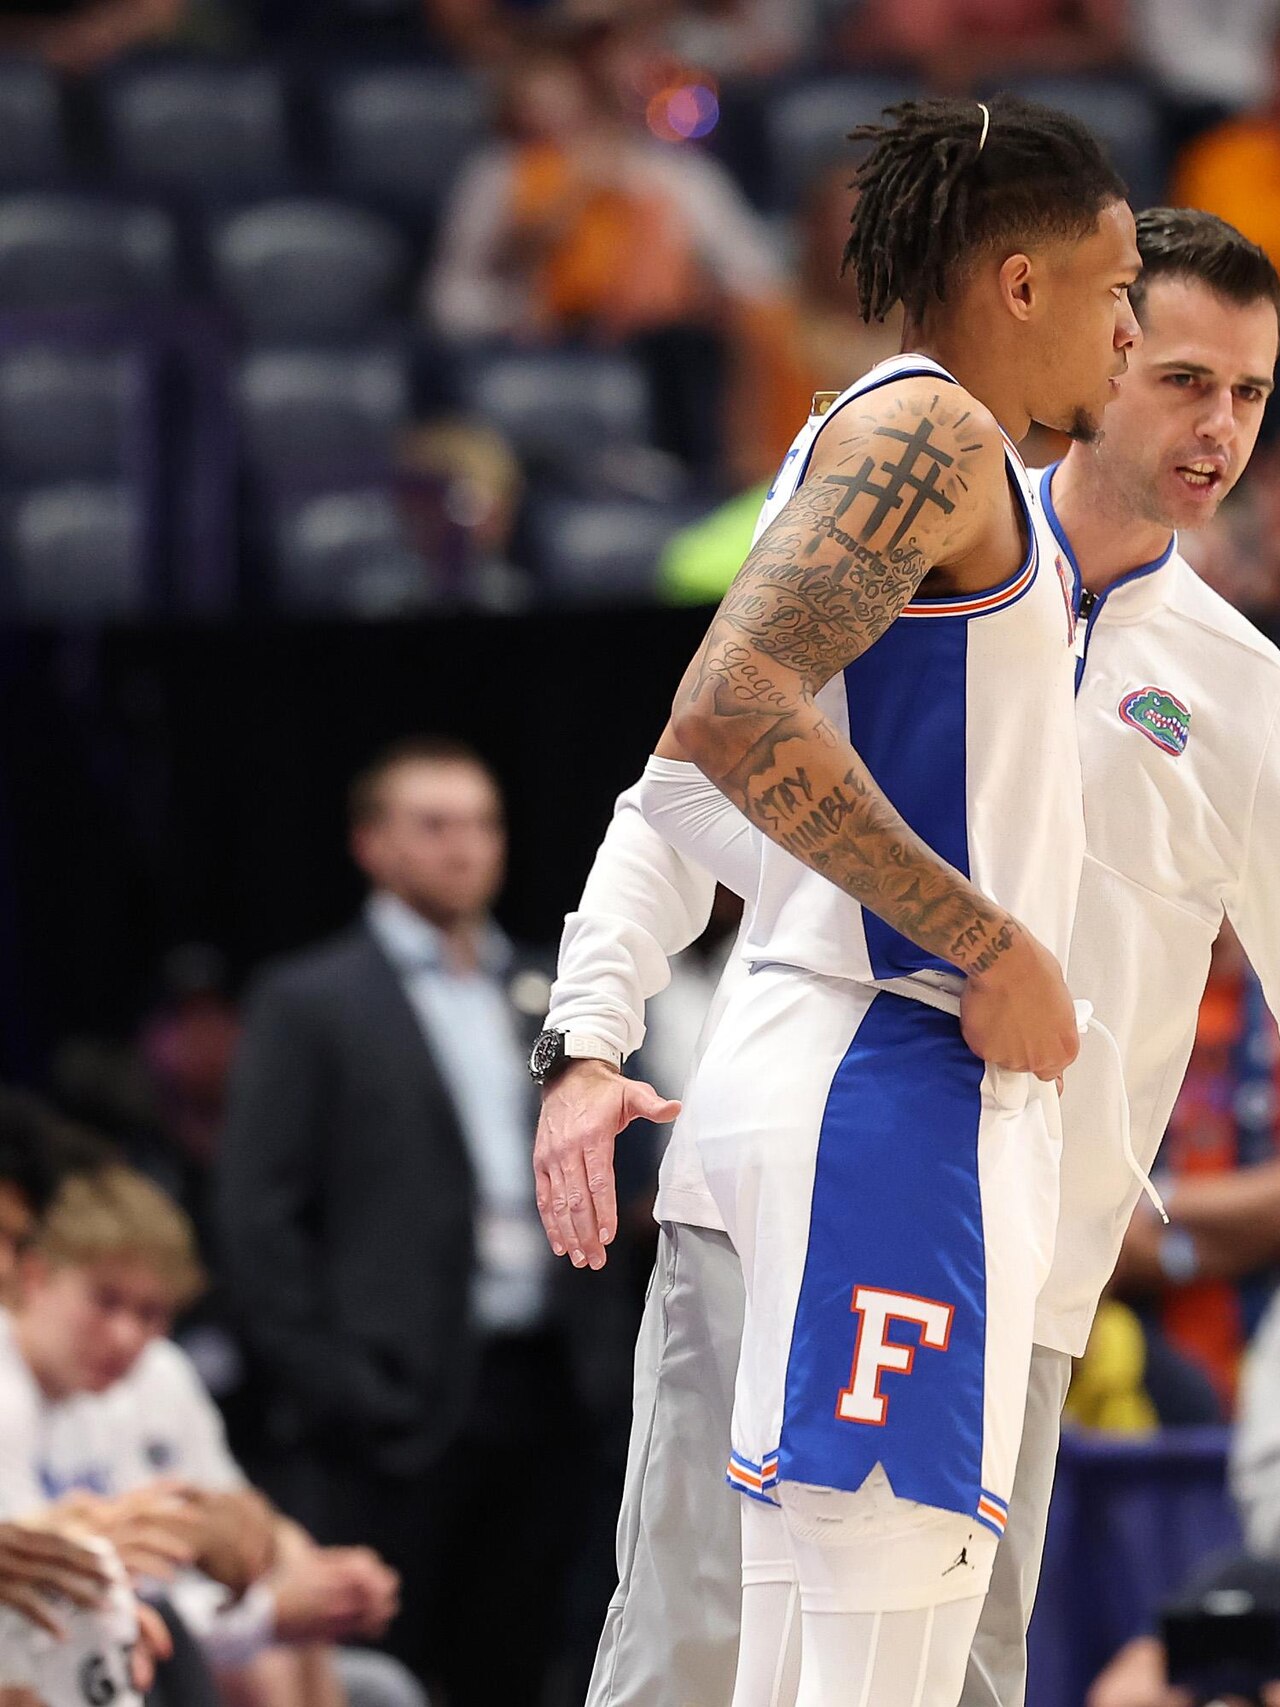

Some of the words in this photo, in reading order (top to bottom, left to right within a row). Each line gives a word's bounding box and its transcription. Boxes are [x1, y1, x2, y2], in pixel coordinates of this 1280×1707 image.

[752, 766, 813, 831] STAY
[950, 919, 988, 960] STAY
[834, 1284, 955, 1426] F
